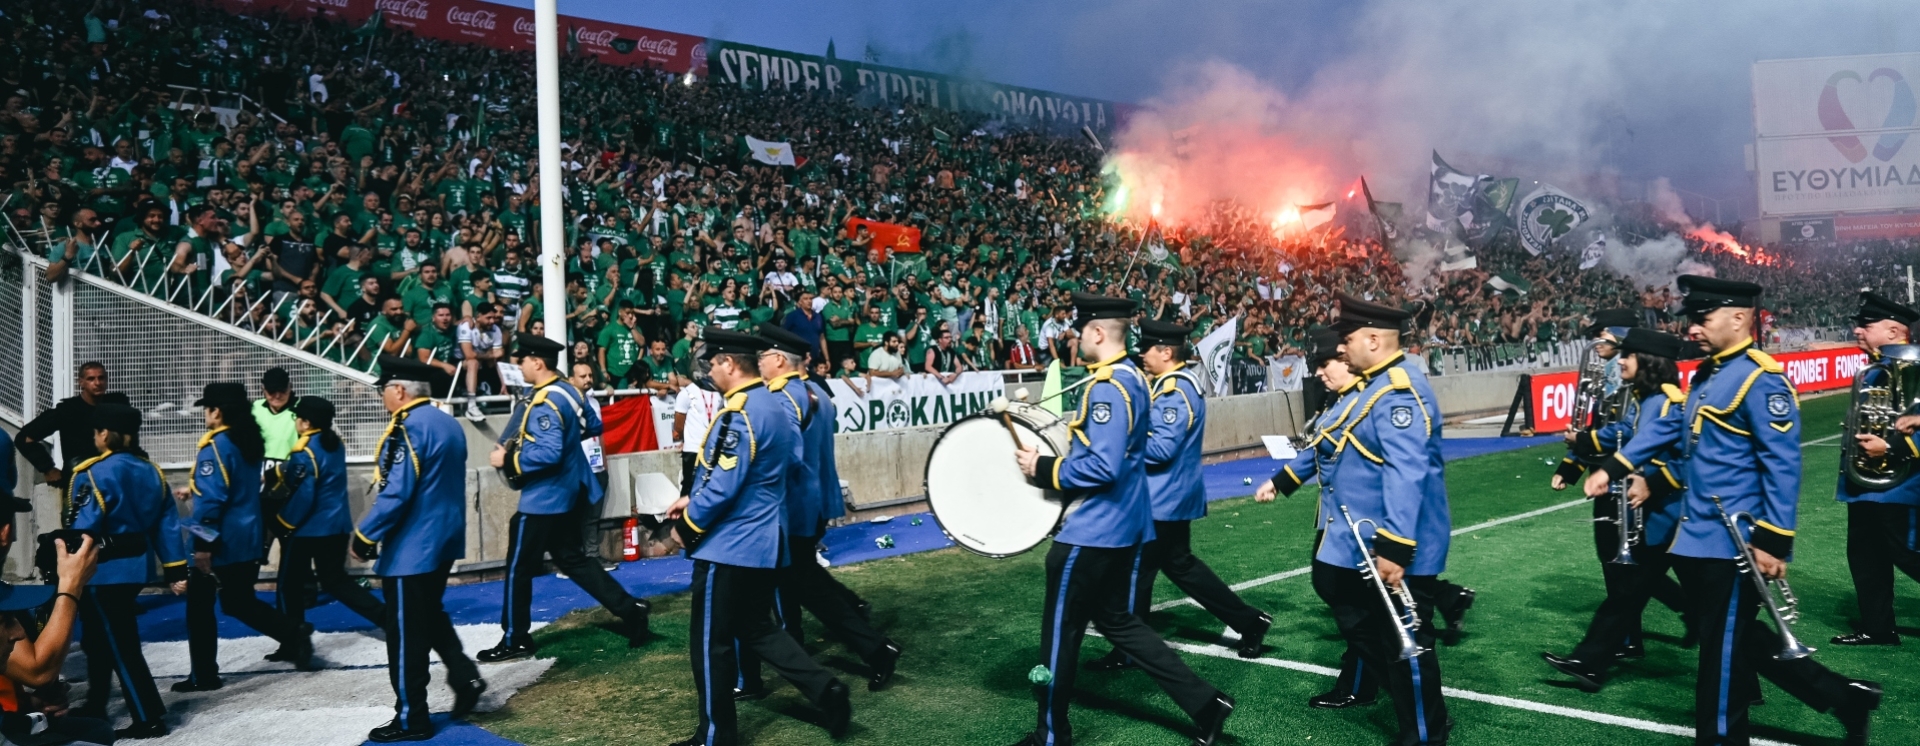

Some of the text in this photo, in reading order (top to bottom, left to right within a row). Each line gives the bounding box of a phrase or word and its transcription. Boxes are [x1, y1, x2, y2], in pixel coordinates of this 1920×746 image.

[575, 26, 619, 47] Coca-Co
[719, 48, 842, 95] SEMPER
[1787, 357, 1828, 385] FONBET
[1542, 383, 1578, 421] FON
